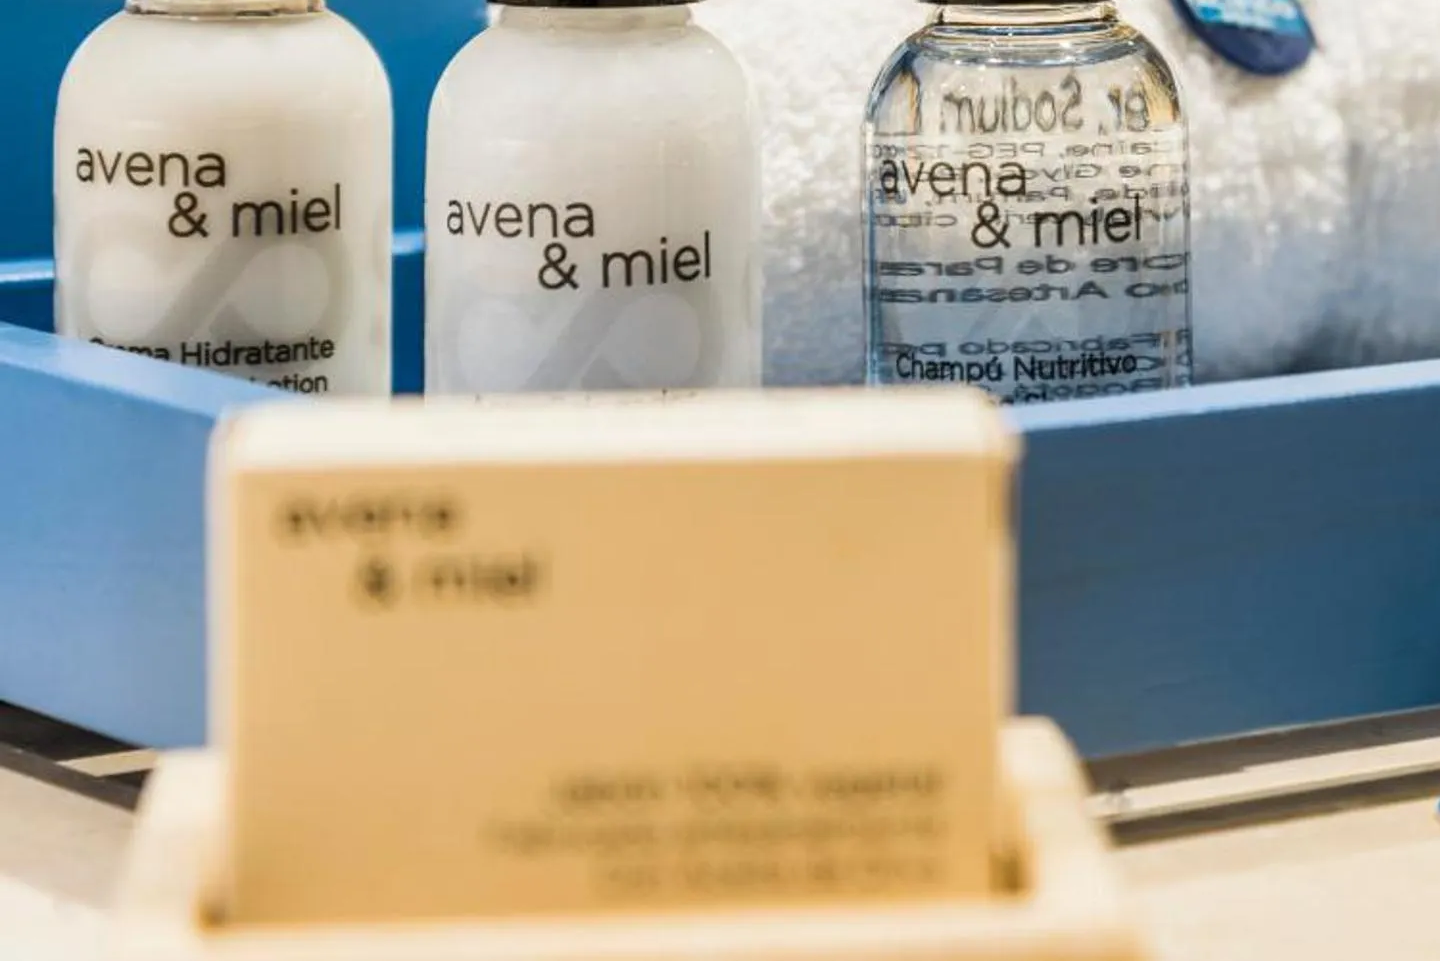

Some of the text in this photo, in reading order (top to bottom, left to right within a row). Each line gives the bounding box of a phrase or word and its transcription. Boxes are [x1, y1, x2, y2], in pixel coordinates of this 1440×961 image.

[76, 147, 226, 187] avena
[879, 159, 1027, 197] avena
[168, 183, 341, 237] & miel
[447, 200, 595, 238] avena
[971, 192, 1141, 248] & miel
[538, 230, 711, 290] & miel
[180, 337, 335, 366] Hidratante
[1013, 354, 1138, 382] Nutritivo
